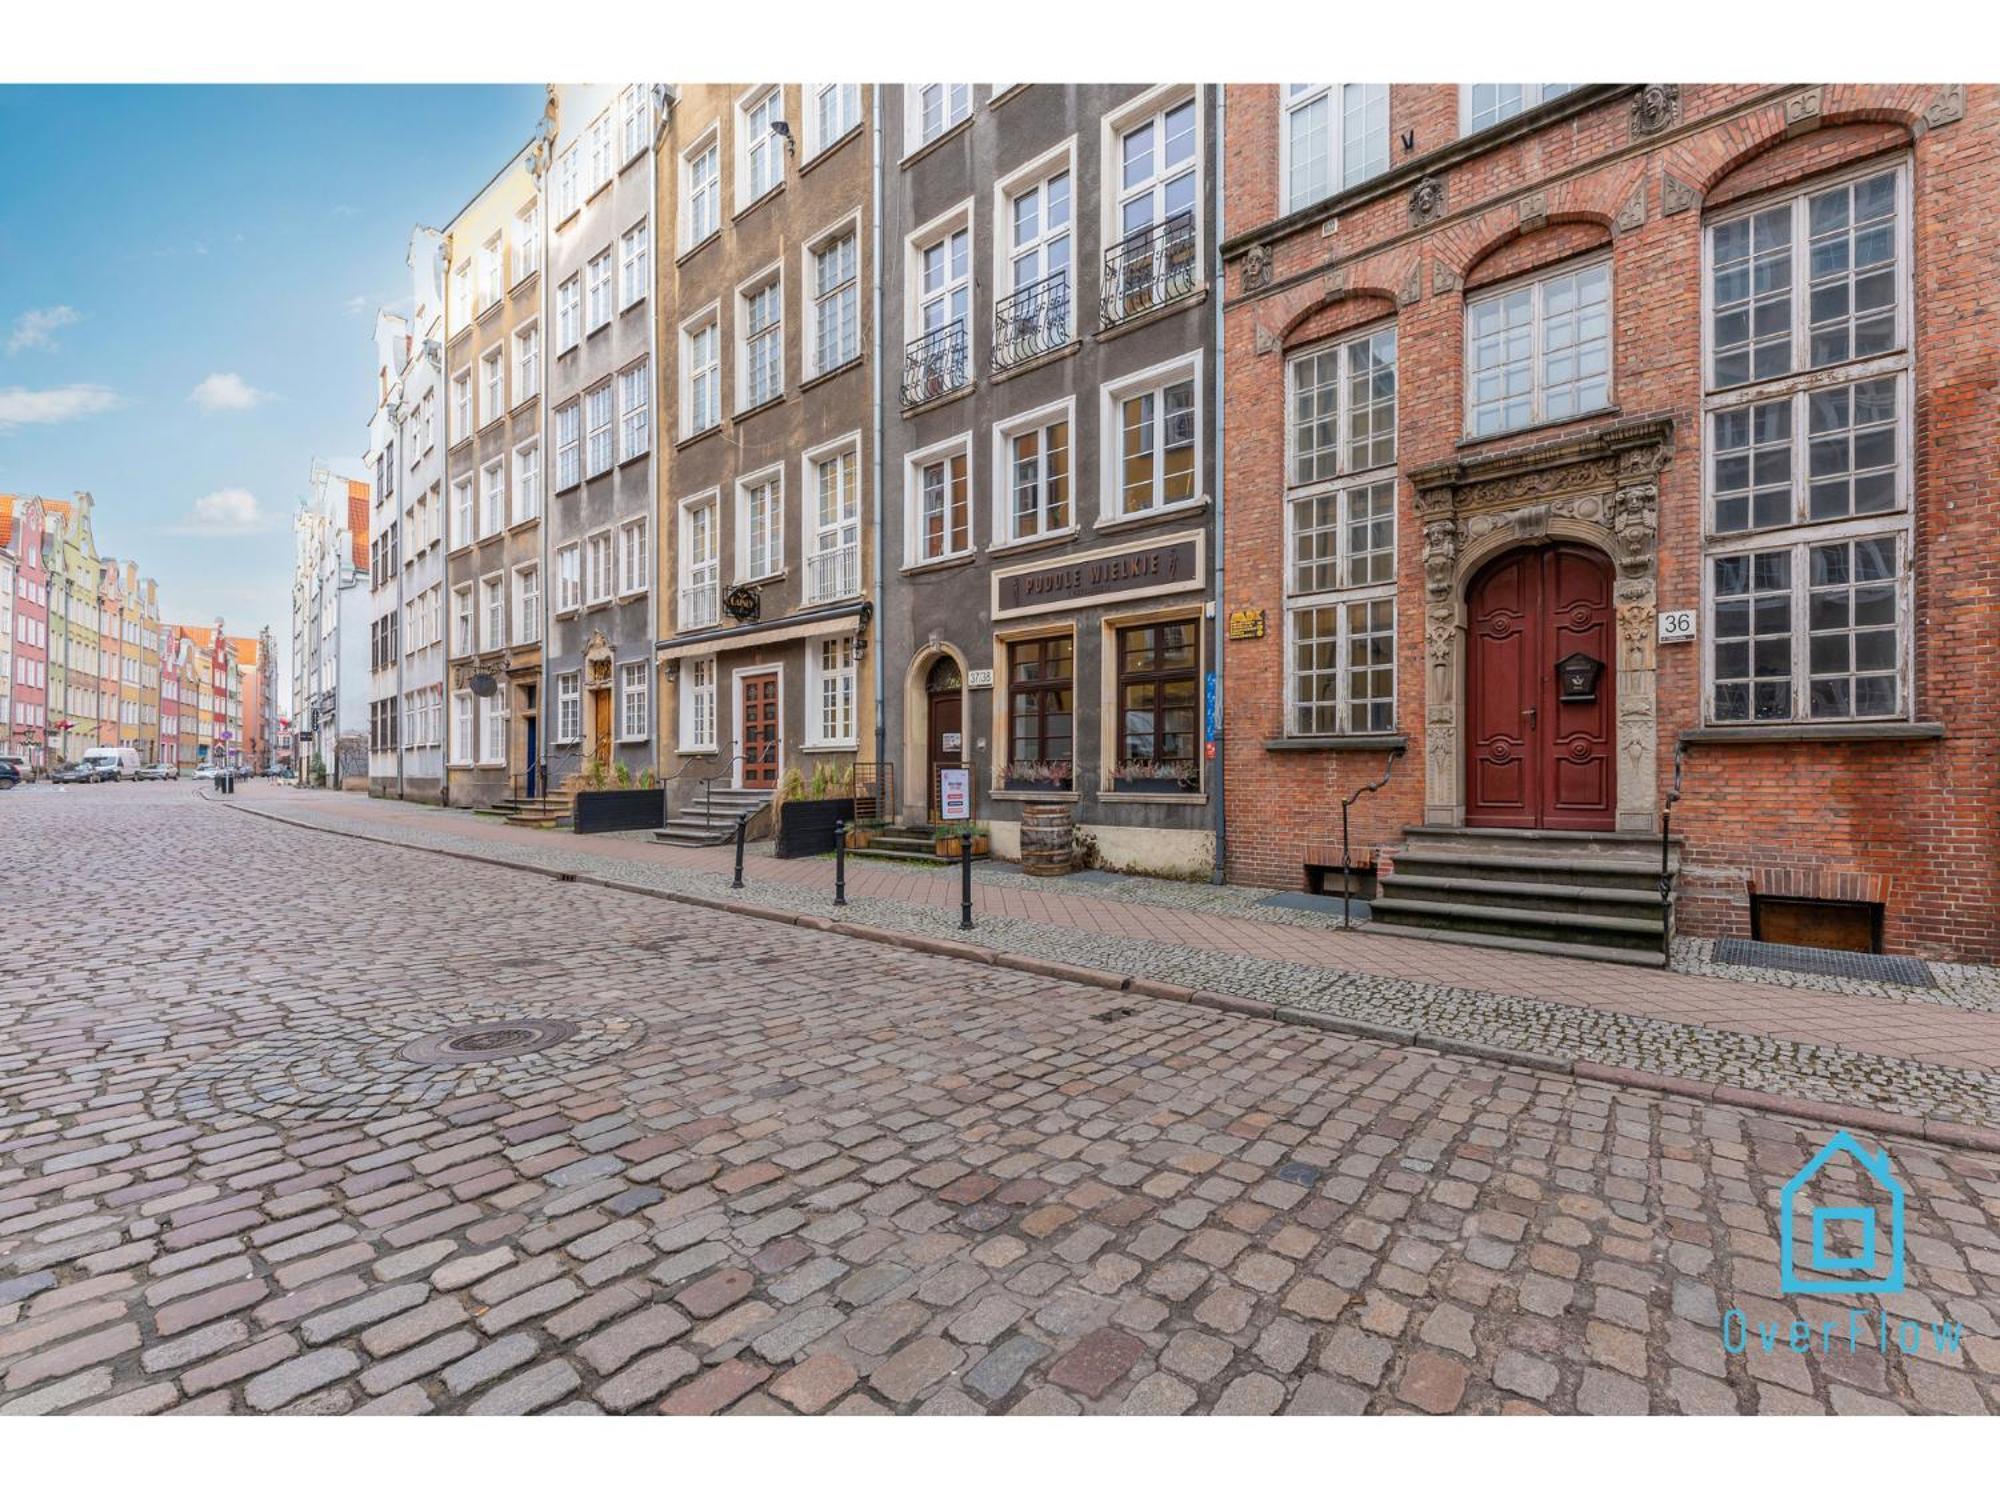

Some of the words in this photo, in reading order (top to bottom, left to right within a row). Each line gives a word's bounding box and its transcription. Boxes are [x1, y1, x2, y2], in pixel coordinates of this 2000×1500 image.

[1090, 555, 1160, 585] WIELKIE
[1665, 613, 1690, 633] 36
[970, 671, 992, 684] 37/38
